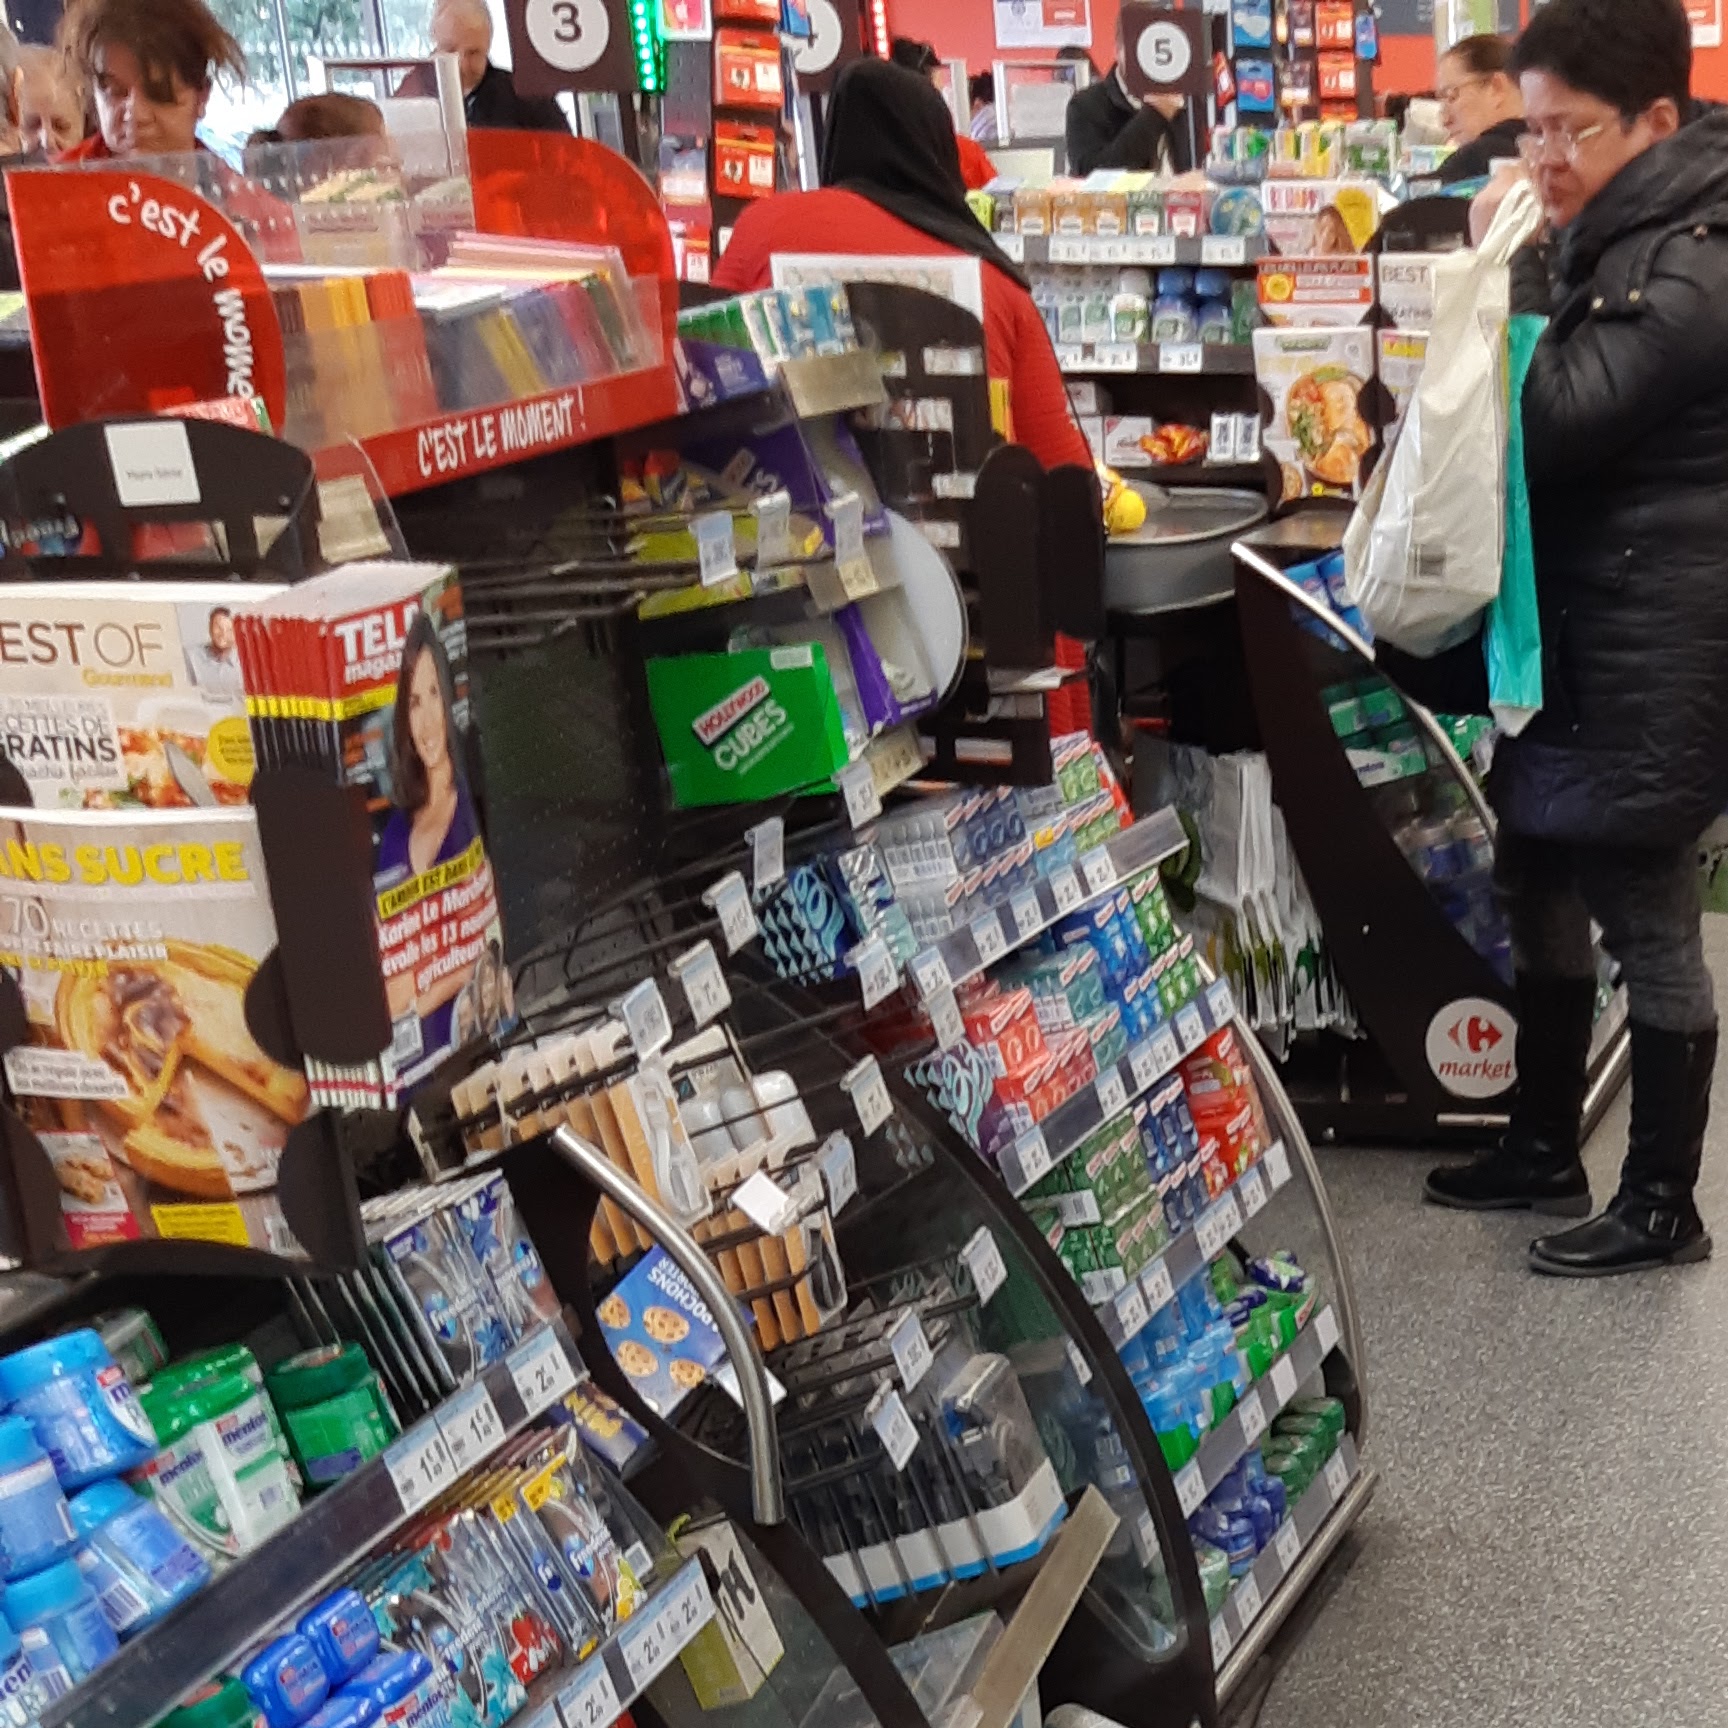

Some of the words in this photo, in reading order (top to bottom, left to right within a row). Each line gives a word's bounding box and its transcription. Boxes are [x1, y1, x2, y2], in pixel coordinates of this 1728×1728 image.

[551, 1, 582, 43] 3
[1154, 37, 1173, 67] 5
[107, 180, 202, 248] c'est
[196, 233, 230, 284] le
[212, 286, 255, 400] mome
[417, 419, 469, 479] C'EST
[471, 413, 498, 460] LE
[500, 393, 575, 454] MOMENT
[0, 619, 86, 667] EST
[93, 621, 164, 668] OF
[0, 732, 118, 763] RATINS
[714, 698, 788, 771] CUBES
[0, 837, 72, 883] NS
[74, 841, 250, 886] SUCRE
[1438, 1058, 1512, 1081] market
[159, 1450, 204, 1487] mento
